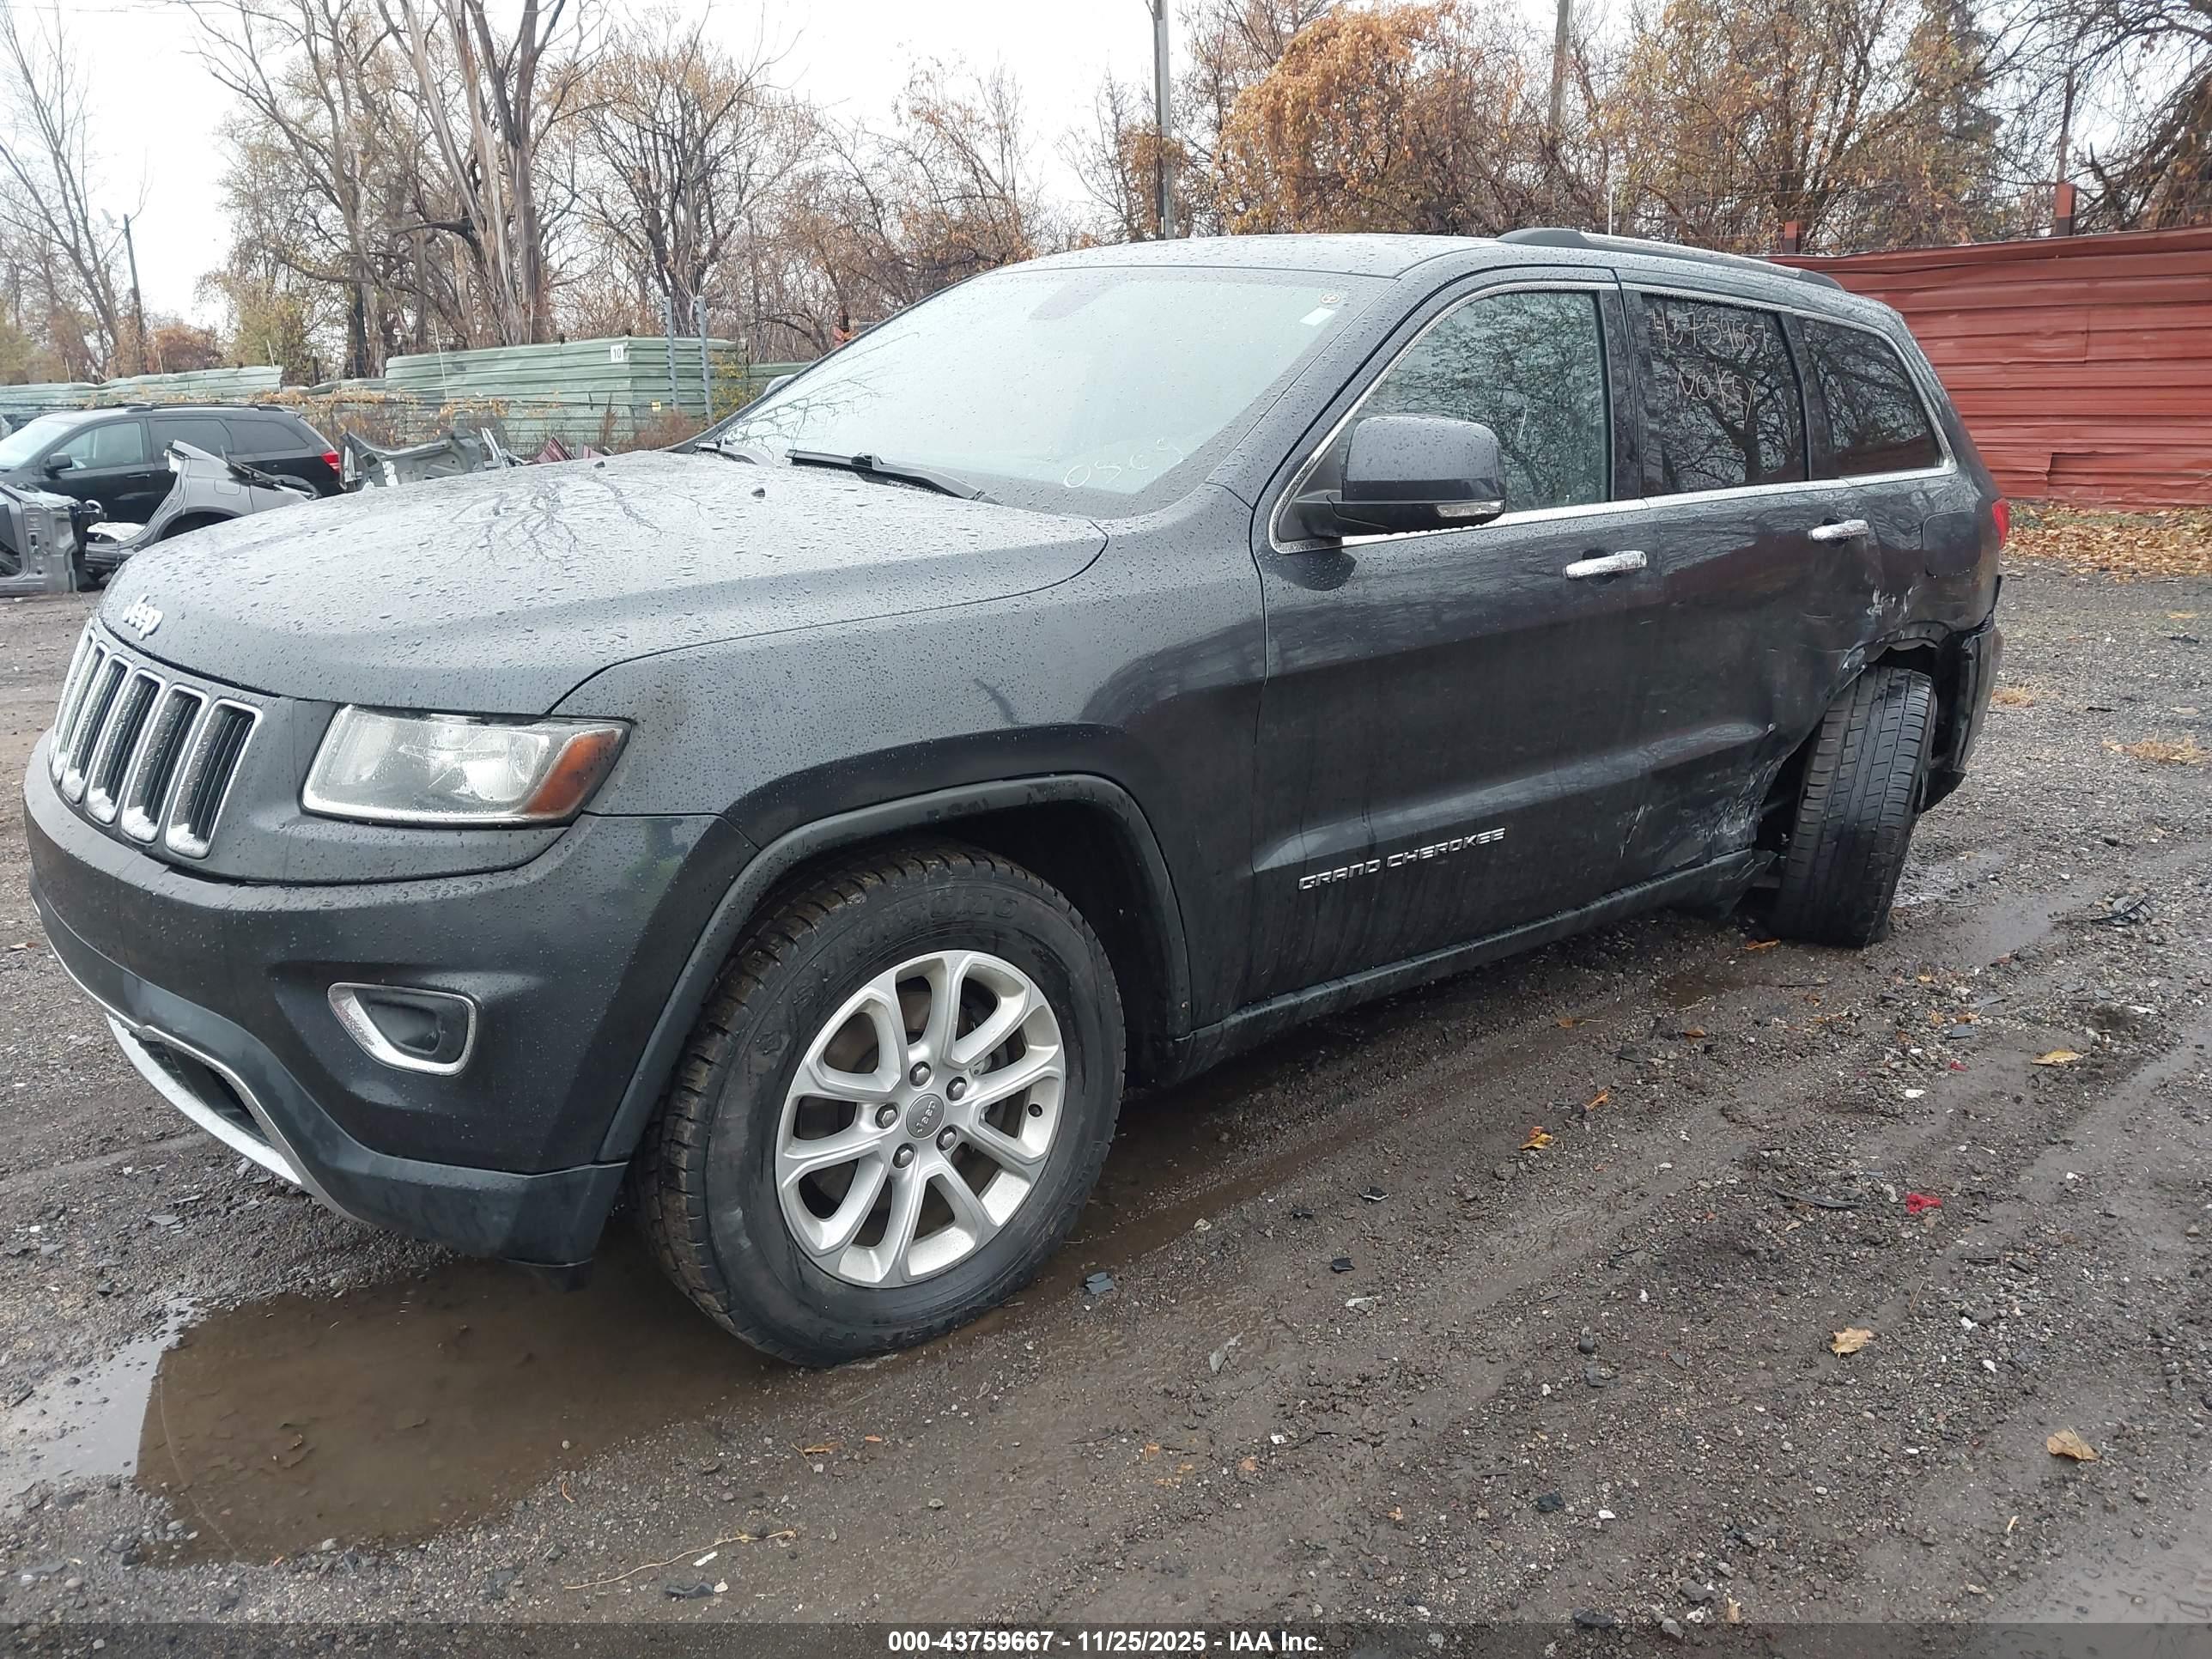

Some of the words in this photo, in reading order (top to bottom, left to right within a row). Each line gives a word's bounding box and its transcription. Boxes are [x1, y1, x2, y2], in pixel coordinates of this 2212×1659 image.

[613, 349, 622, 359] 10
[1652, 308, 1769, 356] 43759667
[1676, 368, 1711, 405] NO
[122, 592, 164, 641] Jeep
[1298, 859, 1382, 890] GRAND
[1387, 827, 1506, 869] CHEROKEE
